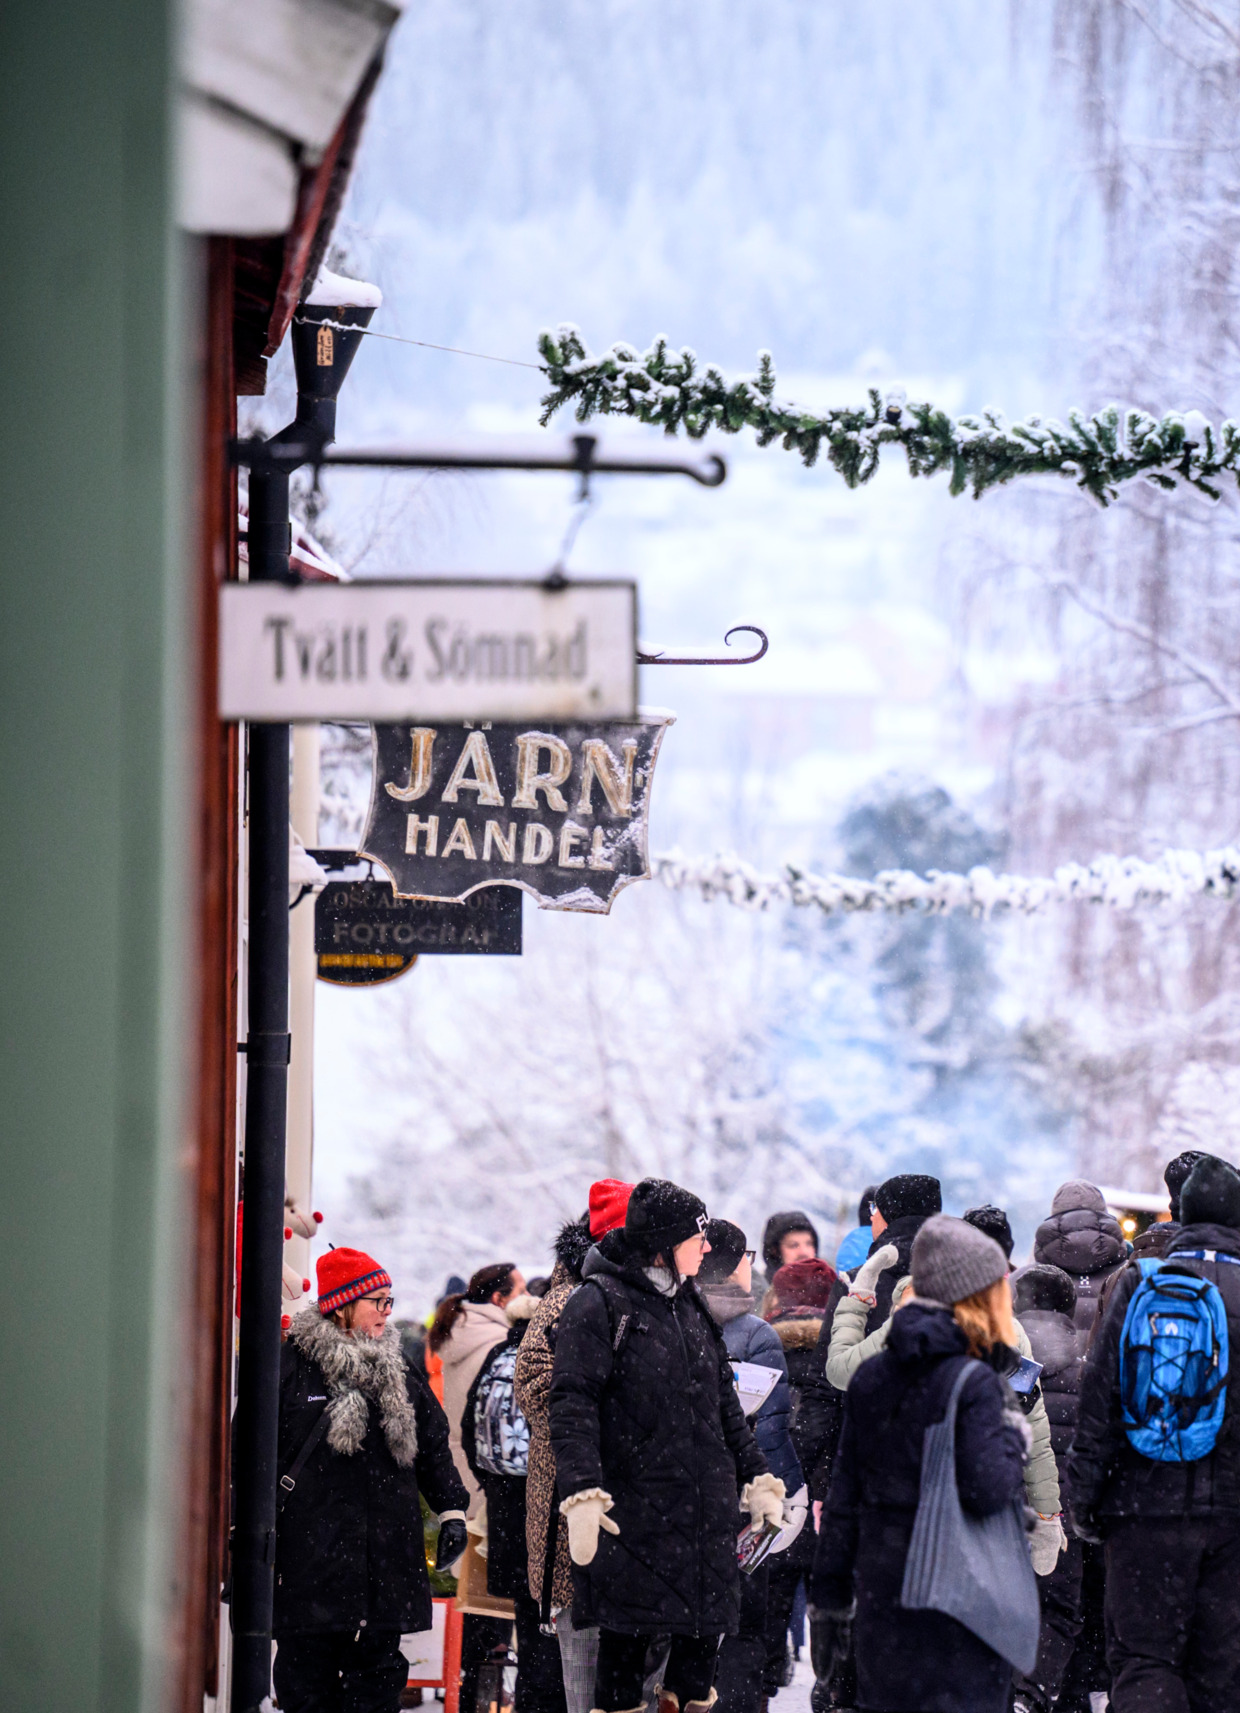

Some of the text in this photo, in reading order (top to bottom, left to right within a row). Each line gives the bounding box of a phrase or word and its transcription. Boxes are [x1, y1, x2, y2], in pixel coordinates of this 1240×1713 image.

[264, 614, 588, 684] Tvätt & Sömnad
[405, 814, 615, 871] HANDEL
